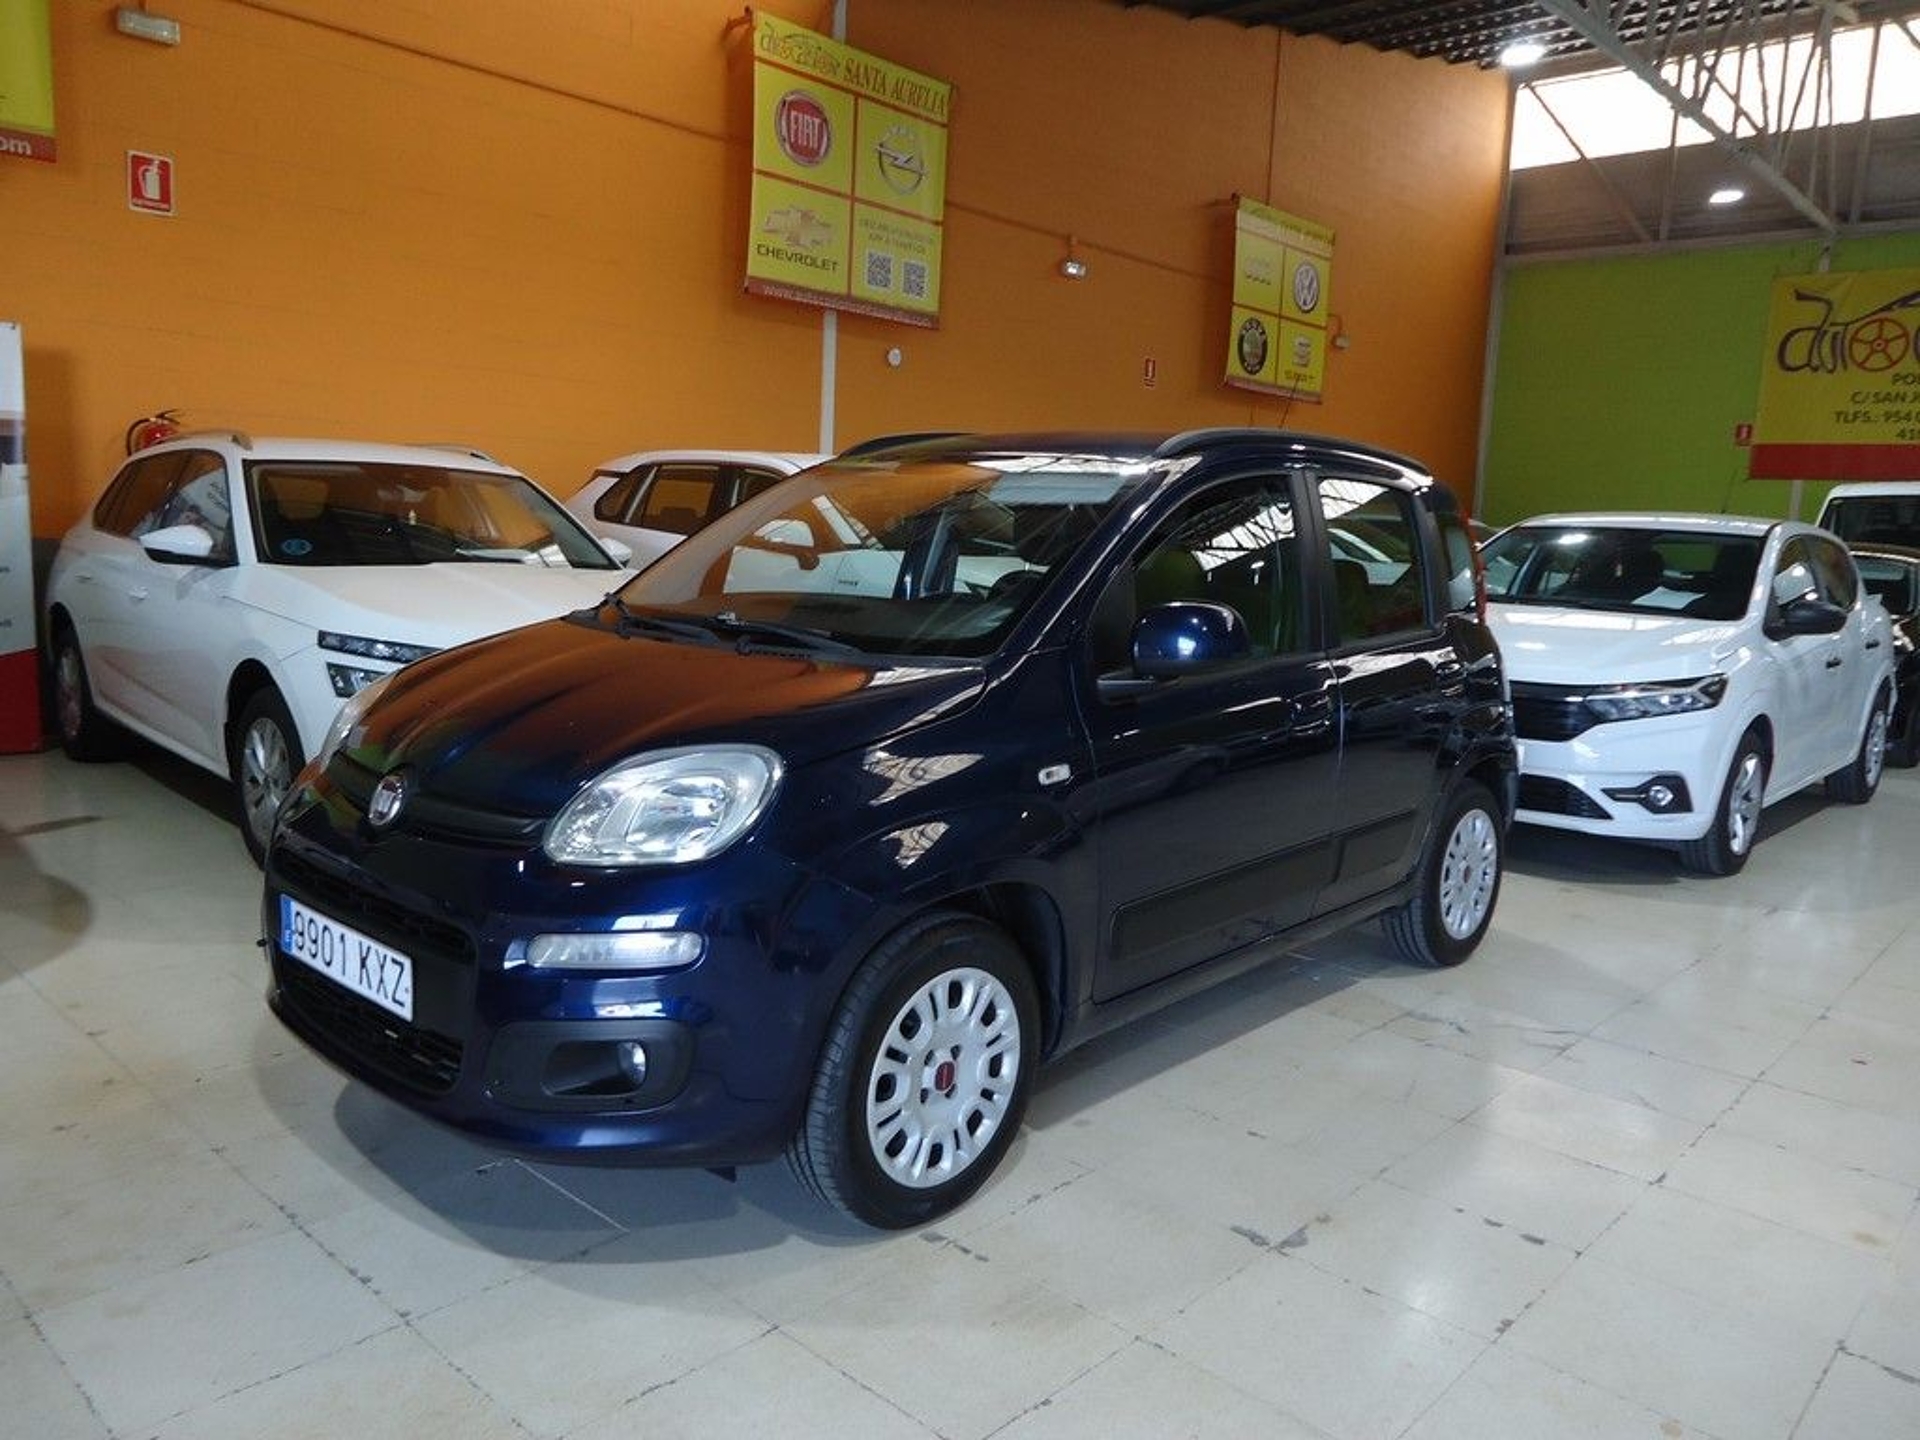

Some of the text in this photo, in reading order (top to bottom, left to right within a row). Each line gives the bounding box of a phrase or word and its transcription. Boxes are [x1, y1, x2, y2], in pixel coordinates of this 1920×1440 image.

[842, 57, 887, 96] SANTA
[790, 109, 820, 151] FIAT
[757, 243, 838, 272] CHEVROLET
[294, 911, 406, 1008] 9901 KXZ
